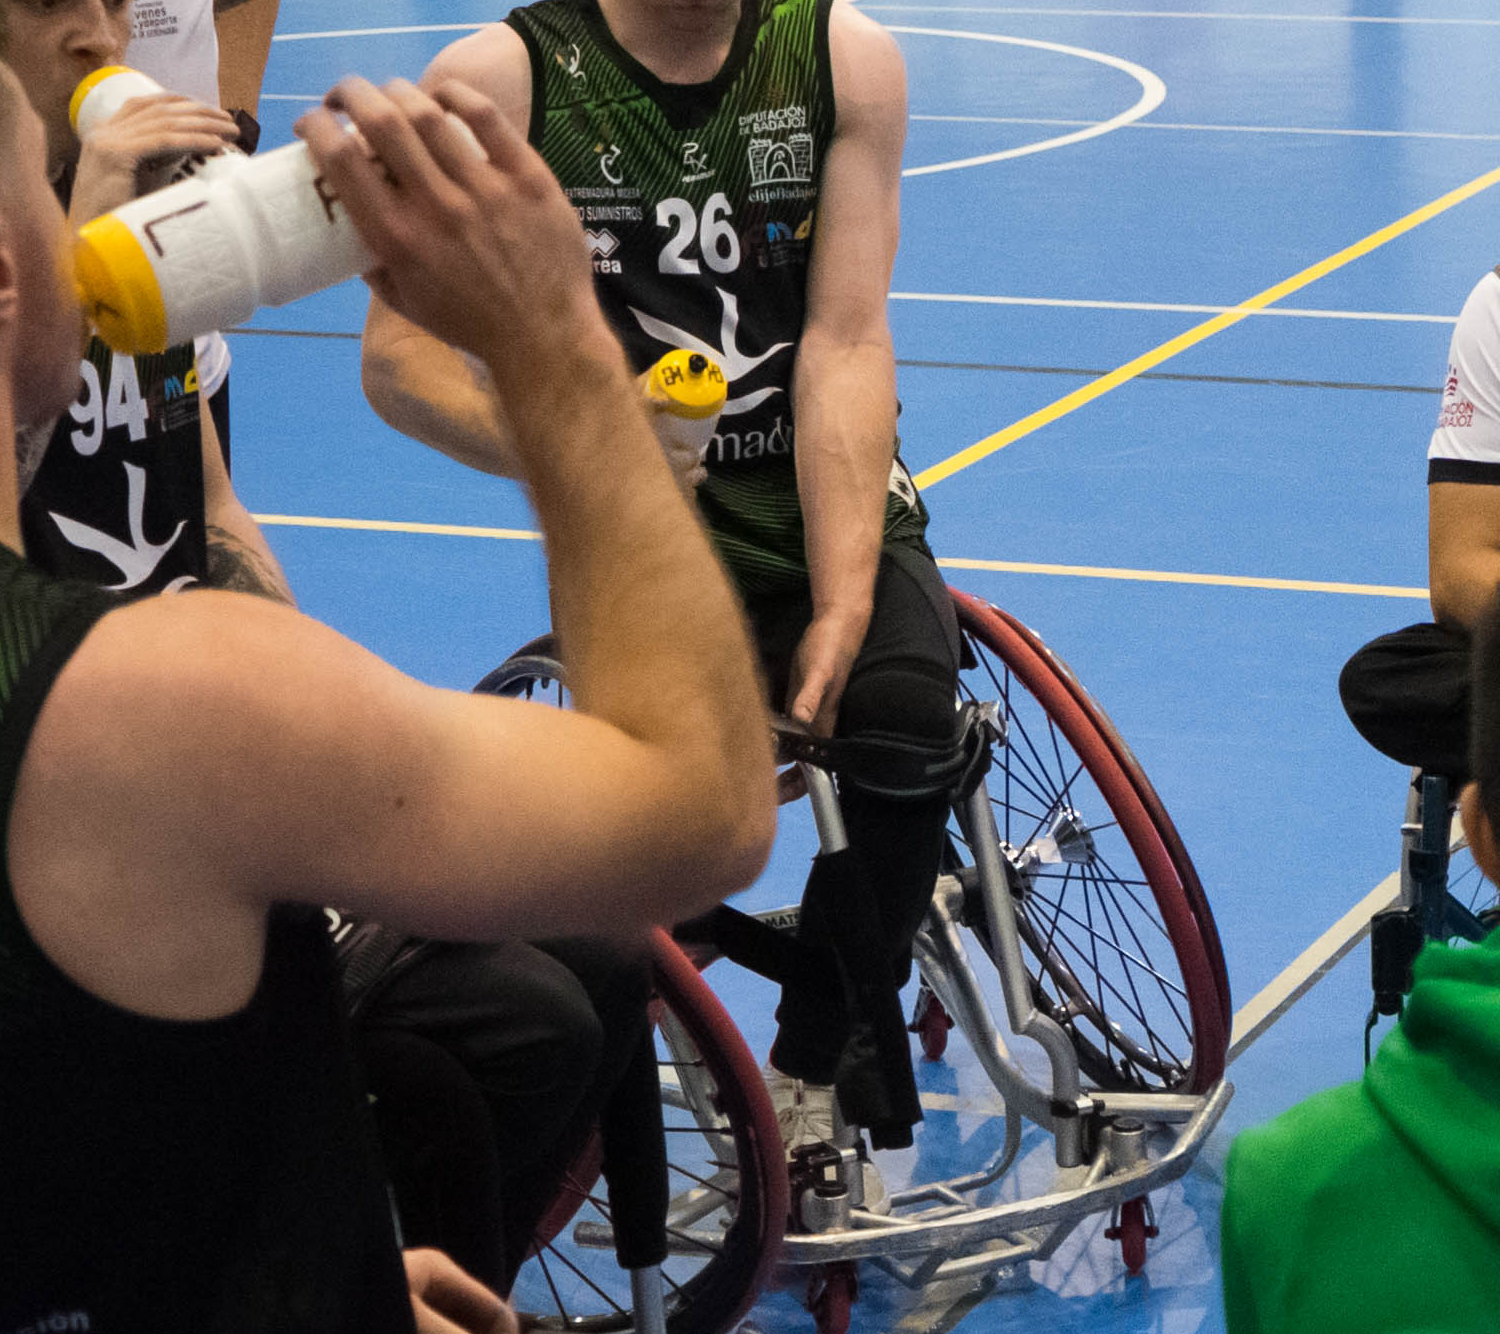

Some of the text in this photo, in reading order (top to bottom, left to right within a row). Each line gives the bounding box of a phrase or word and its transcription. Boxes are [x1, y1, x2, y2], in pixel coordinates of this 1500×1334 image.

[134, 7, 167, 20] venes
[739, 103, 807, 126] DIPUTACIÓN
[753, 116, 807, 133] BADAJOZ
[655, 192, 741, 275] 26
[593, 258, 623, 275] rea
[68, 351, 150, 457] 94
